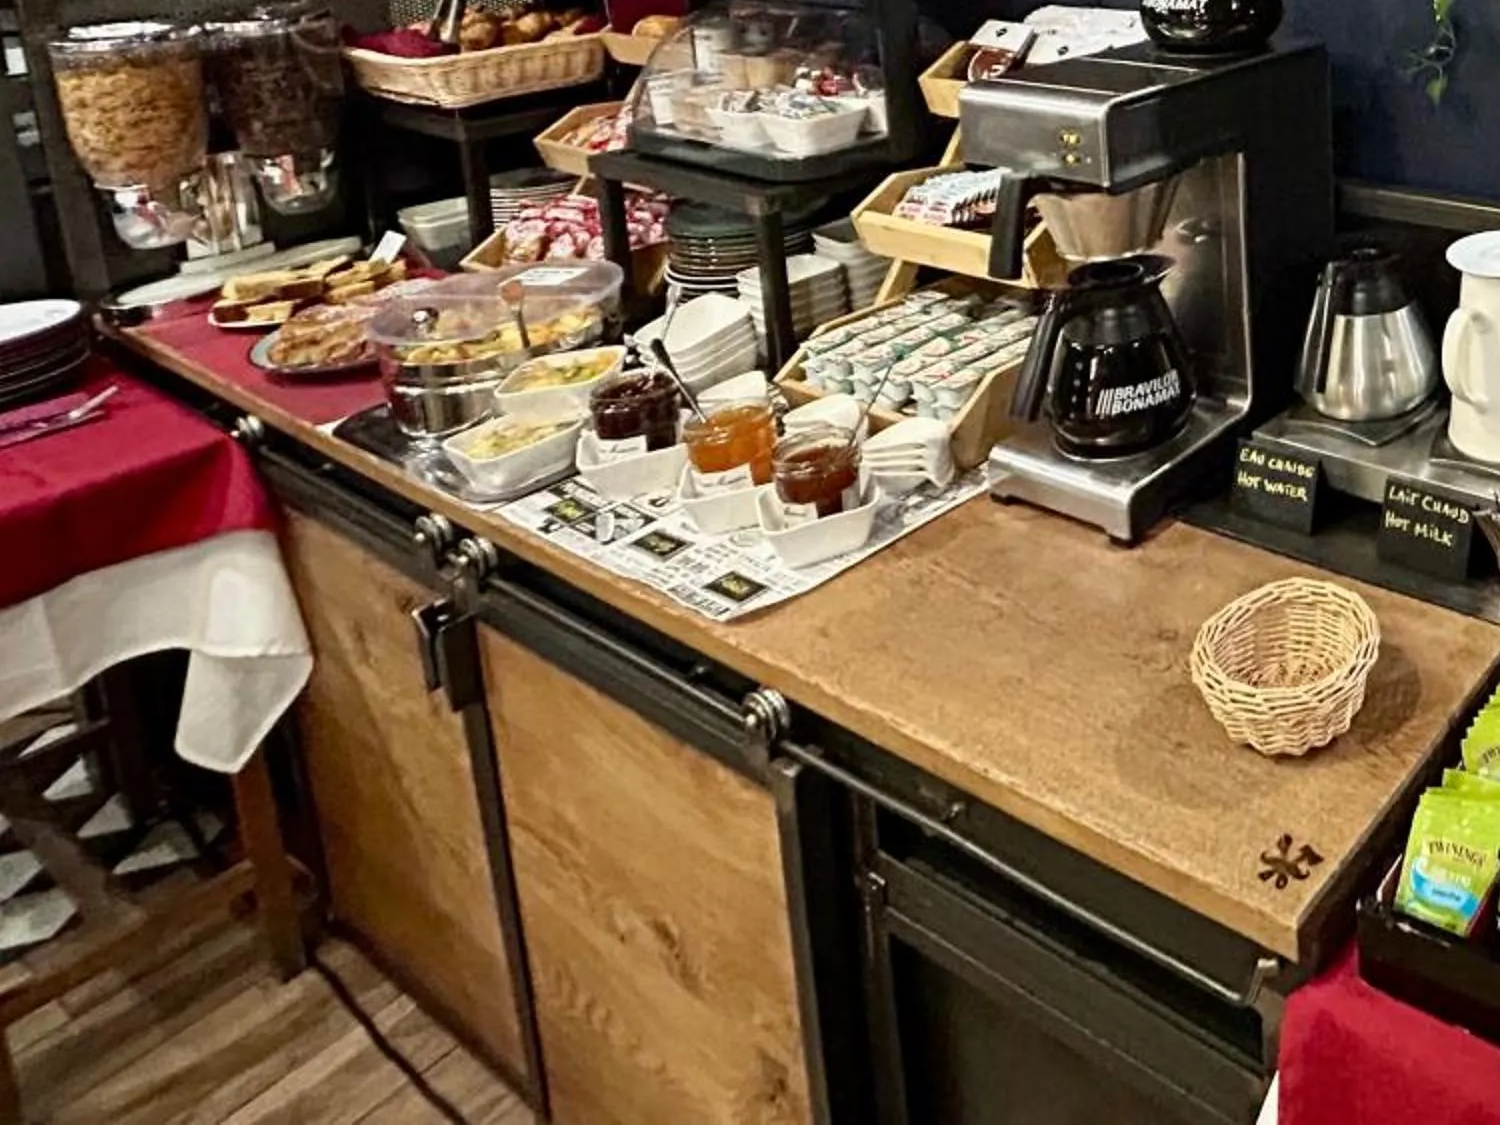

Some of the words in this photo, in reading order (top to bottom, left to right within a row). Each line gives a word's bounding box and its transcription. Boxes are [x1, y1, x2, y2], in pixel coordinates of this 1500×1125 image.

[1111, 381, 1181, 416] BONAMAT
[1114, 369, 1178, 401] BRAVILOR
[1240, 448, 1265, 465] EAU
[1264, 478, 1308, 502] WATER
[1422, 495, 1469, 524] CHAUD
